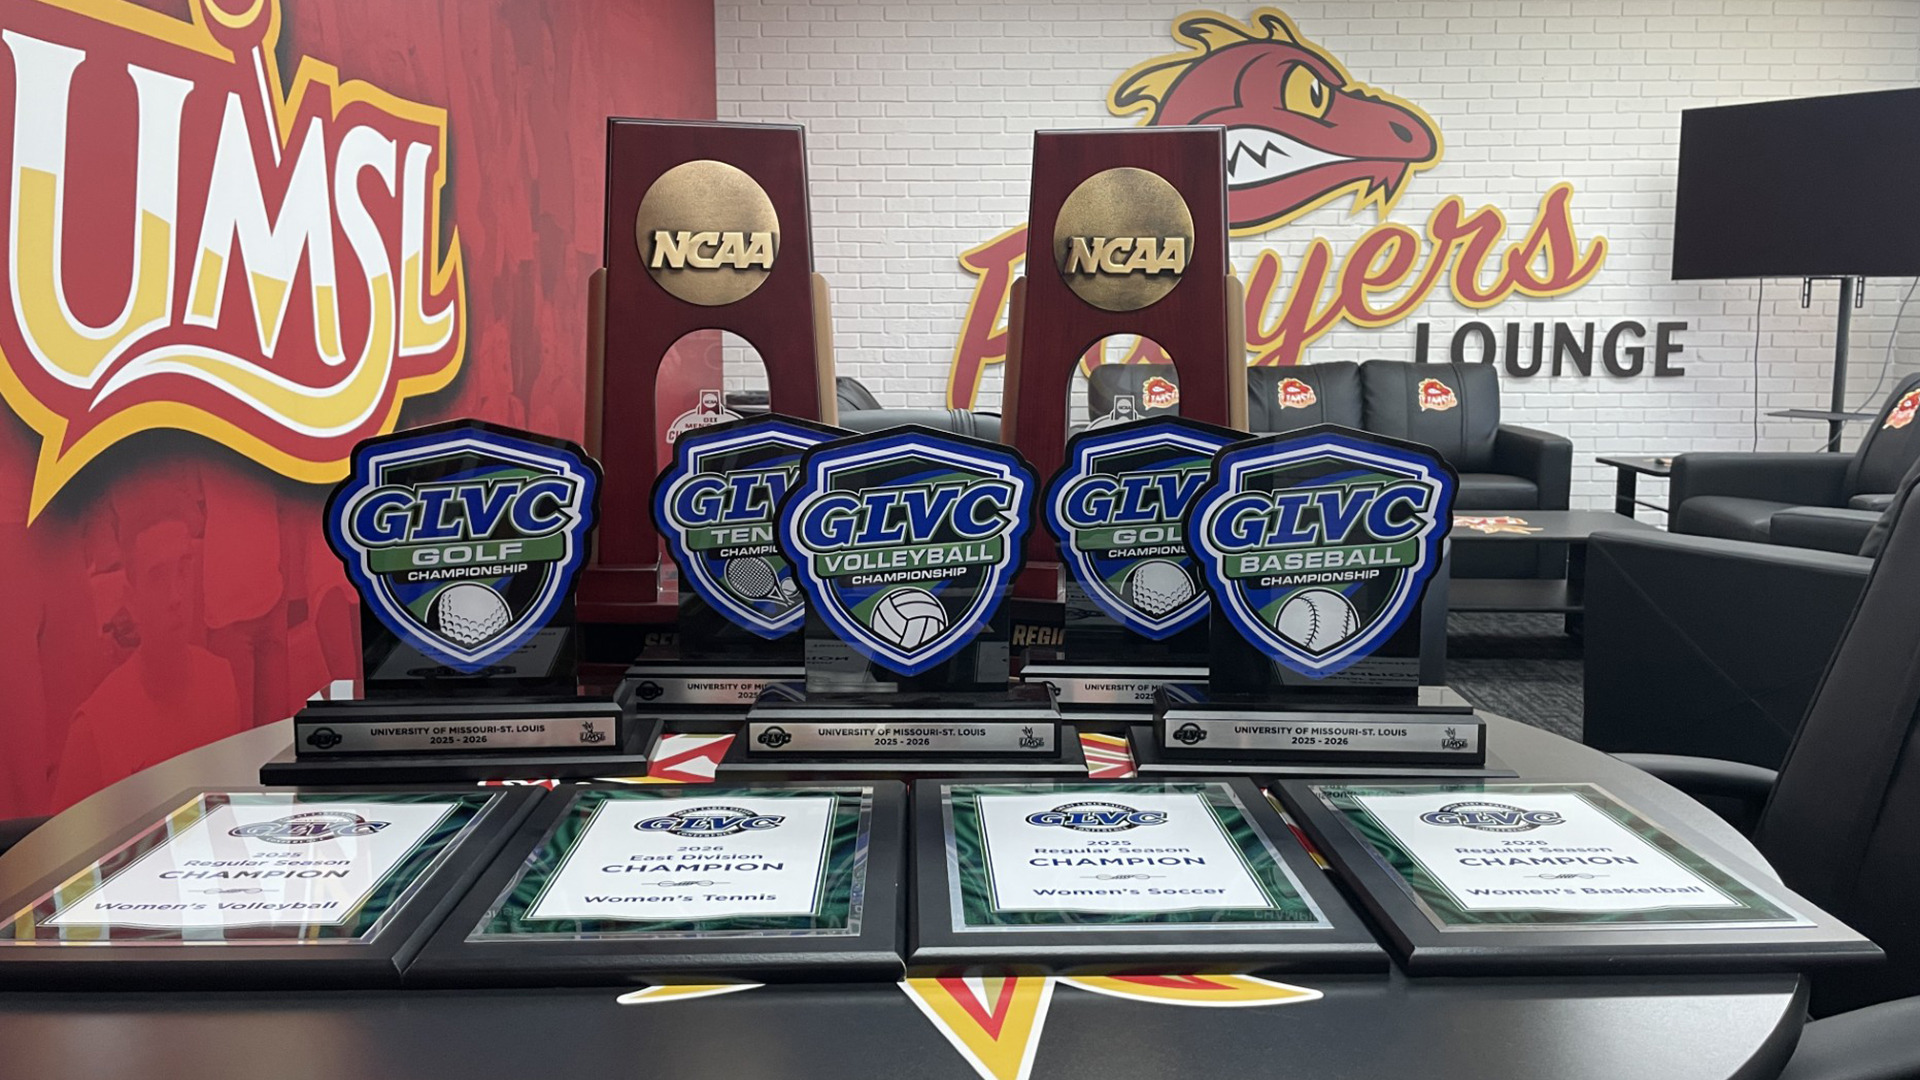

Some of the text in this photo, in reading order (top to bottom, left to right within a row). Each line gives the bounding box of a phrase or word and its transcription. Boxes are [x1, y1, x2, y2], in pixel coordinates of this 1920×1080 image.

[2, 27, 455, 438] UMSL
[650, 229, 776, 271] NCAA
[1063, 235, 1187, 276] NCAA
[948, 181, 1609, 410] Pyers
[1415, 320, 1688, 378] LOUNGE
[670, 466, 800, 528] GLV
[1064, 468, 1211, 528] GLV
[351, 477, 573, 546] GLVC
[800, 481, 1016, 552] GLVC
[1210, 481, 1434, 553] GLVC
[711, 528, 772, 545] TEN
[1113, 527, 1182, 545] GOL
[411, 542, 523, 567] GOLF
[720, 545, 777, 558] CHAMPI
[824, 543, 995, 573] VOLLEYBALL
[1107, 545, 1186, 559] CHAMPIONS
[1240, 547, 1402, 574] BASEBALL
[407, 562, 529, 582] CHAMPIONSHIP
[851, 566, 968, 585] CHAMPIONSHIP
[1260, 569, 1380, 588] CHAMPIONSHIP
[370, 724, 546, 736] UNIVERSITY OF MISSOURI-ST. LOUIS
[818, 728, 986, 737] UNIVERSITY OF MISSOURI-ST. LOUIS
[1234, 726, 1408, 737] UNIVERSITY OF MISSOURI-ST. LOUIS
[430, 736, 455, 745] 2025
[463, 735, 488, 744] 2026
[874, 737, 898, 746] 2025
[906, 737, 931, 746] 2026
[1291, 736, 1316, 745] 2025
[1324, 737, 1349, 746] 2026
[633, 813, 786, 832] GLVC
[1025, 811, 1168, 828] GLVC
[1418, 810, 1567, 828] GLVC
[227, 819, 393, 840] GLVC
[680, 853, 764, 861] Division
[1034, 847, 1111, 856] Regular
[1454, 846, 1538, 855] Regular
[183, 859, 351, 868] Regular Season
[601, 862, 785, 873] CHAMPION
[1028, 857, 1206, 867] CHAMPION
[1458, 855, 1640, 867] CHAMPION
[158, 869, 351, 880] CHAMPION
[583, 893, 778, 904] Women's Tennis
[1032, 887, 1228, 897] Women's Soccer
[1466, 885, 1708, 897] Women's Basketball
[94, 900, 340, 912] Women's Volleyball
